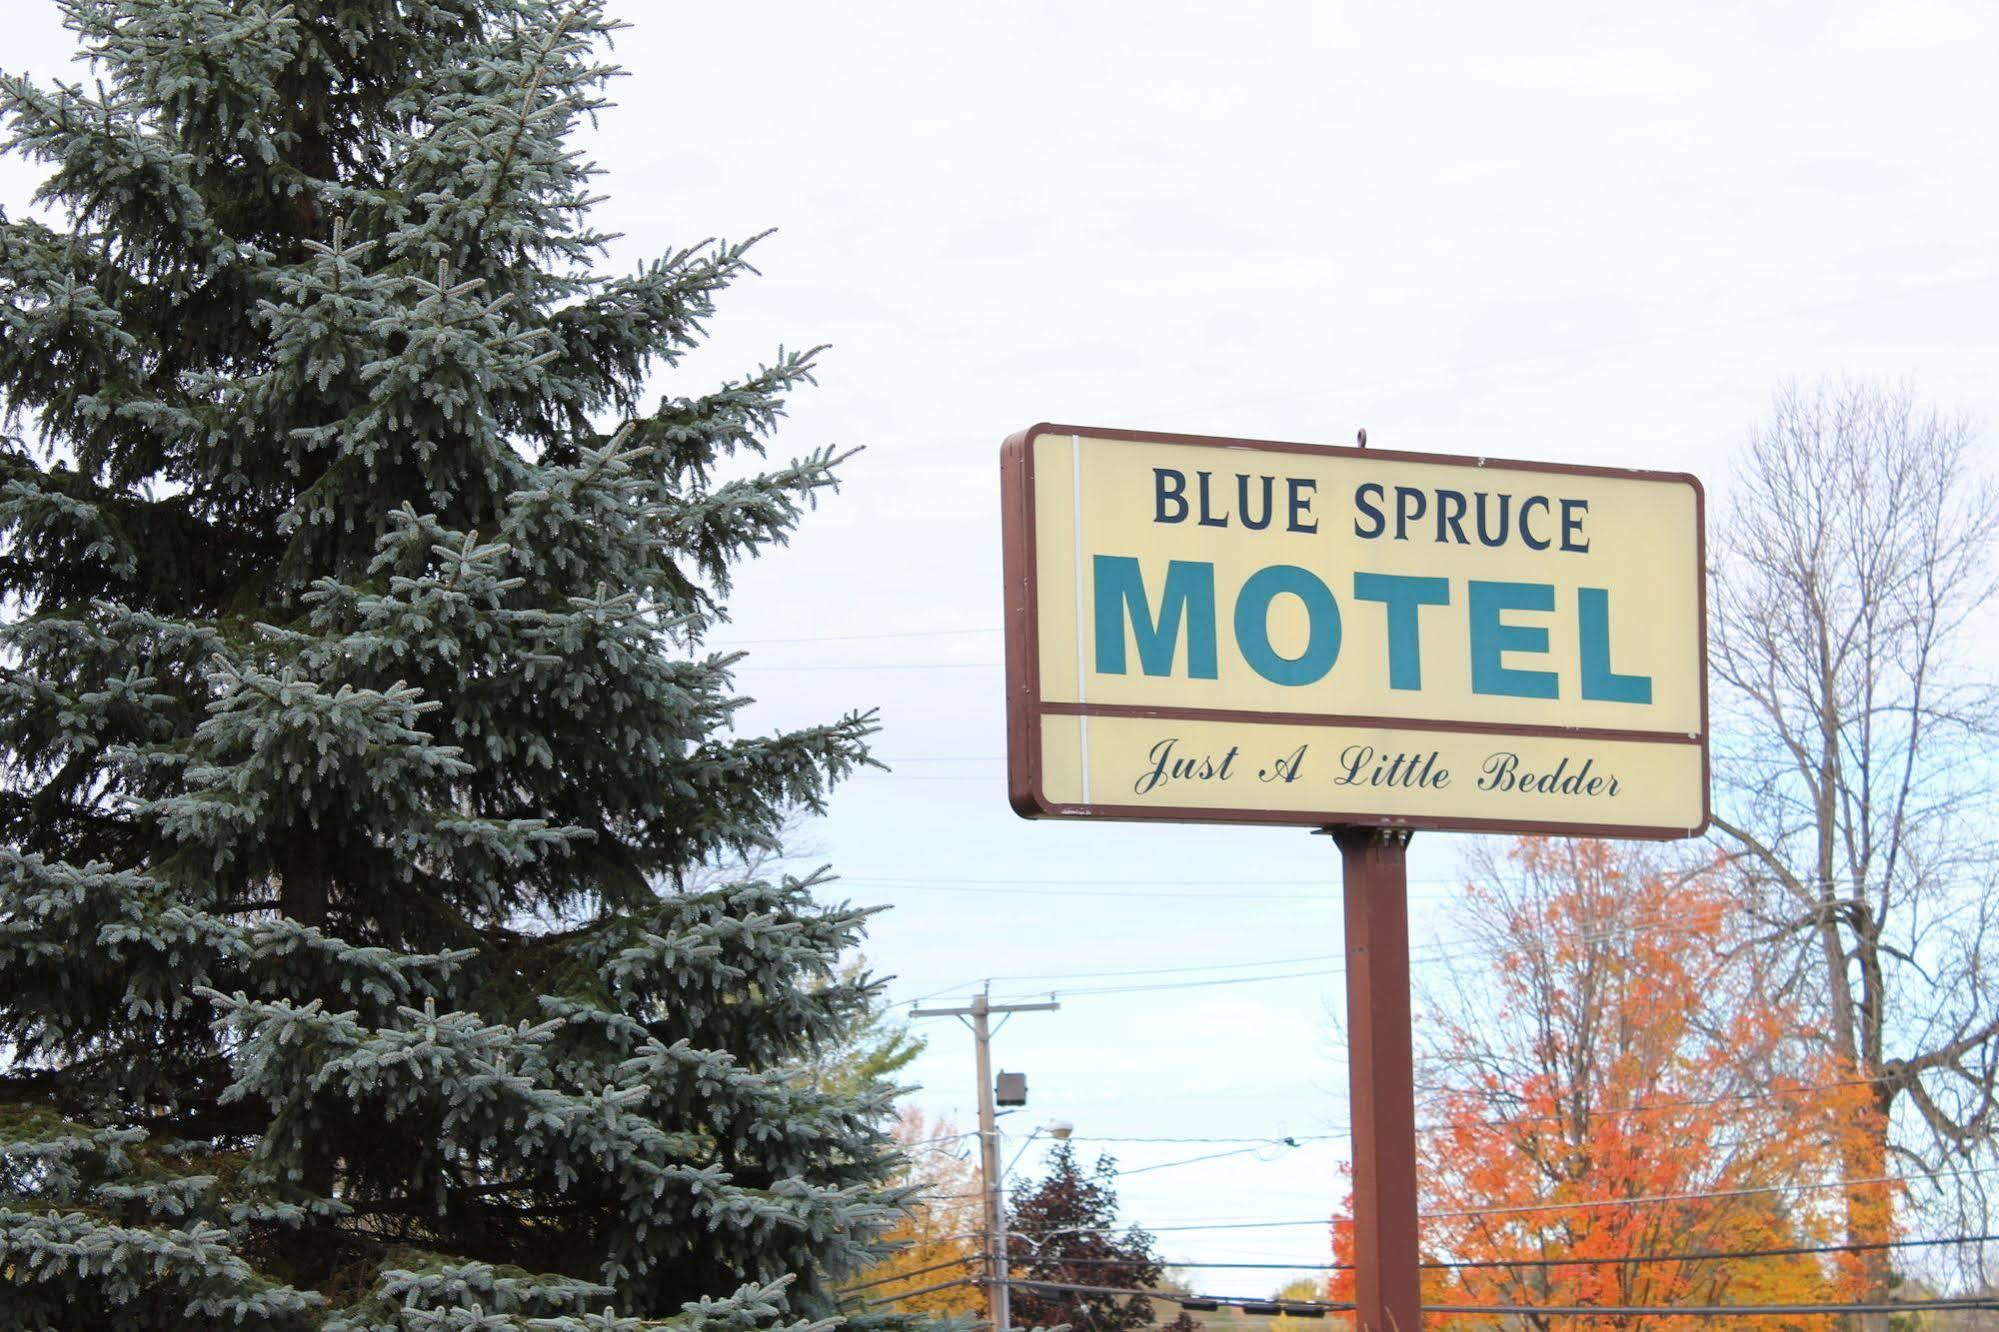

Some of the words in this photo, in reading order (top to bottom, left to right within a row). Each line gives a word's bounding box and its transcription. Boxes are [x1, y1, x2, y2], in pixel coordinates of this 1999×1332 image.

[1152, 468, 1318, 534] BLUE
[1354, 483, 1590, 554] SPRUCE
[1093, 554, 1652, 705] MOTEL
[1134, 738, 1238, 795] Just
[1258, 743, 1307, 783] A
[1334, 745, 1450, 789] Little
[1477, 752, 1620, 797] Bedder
